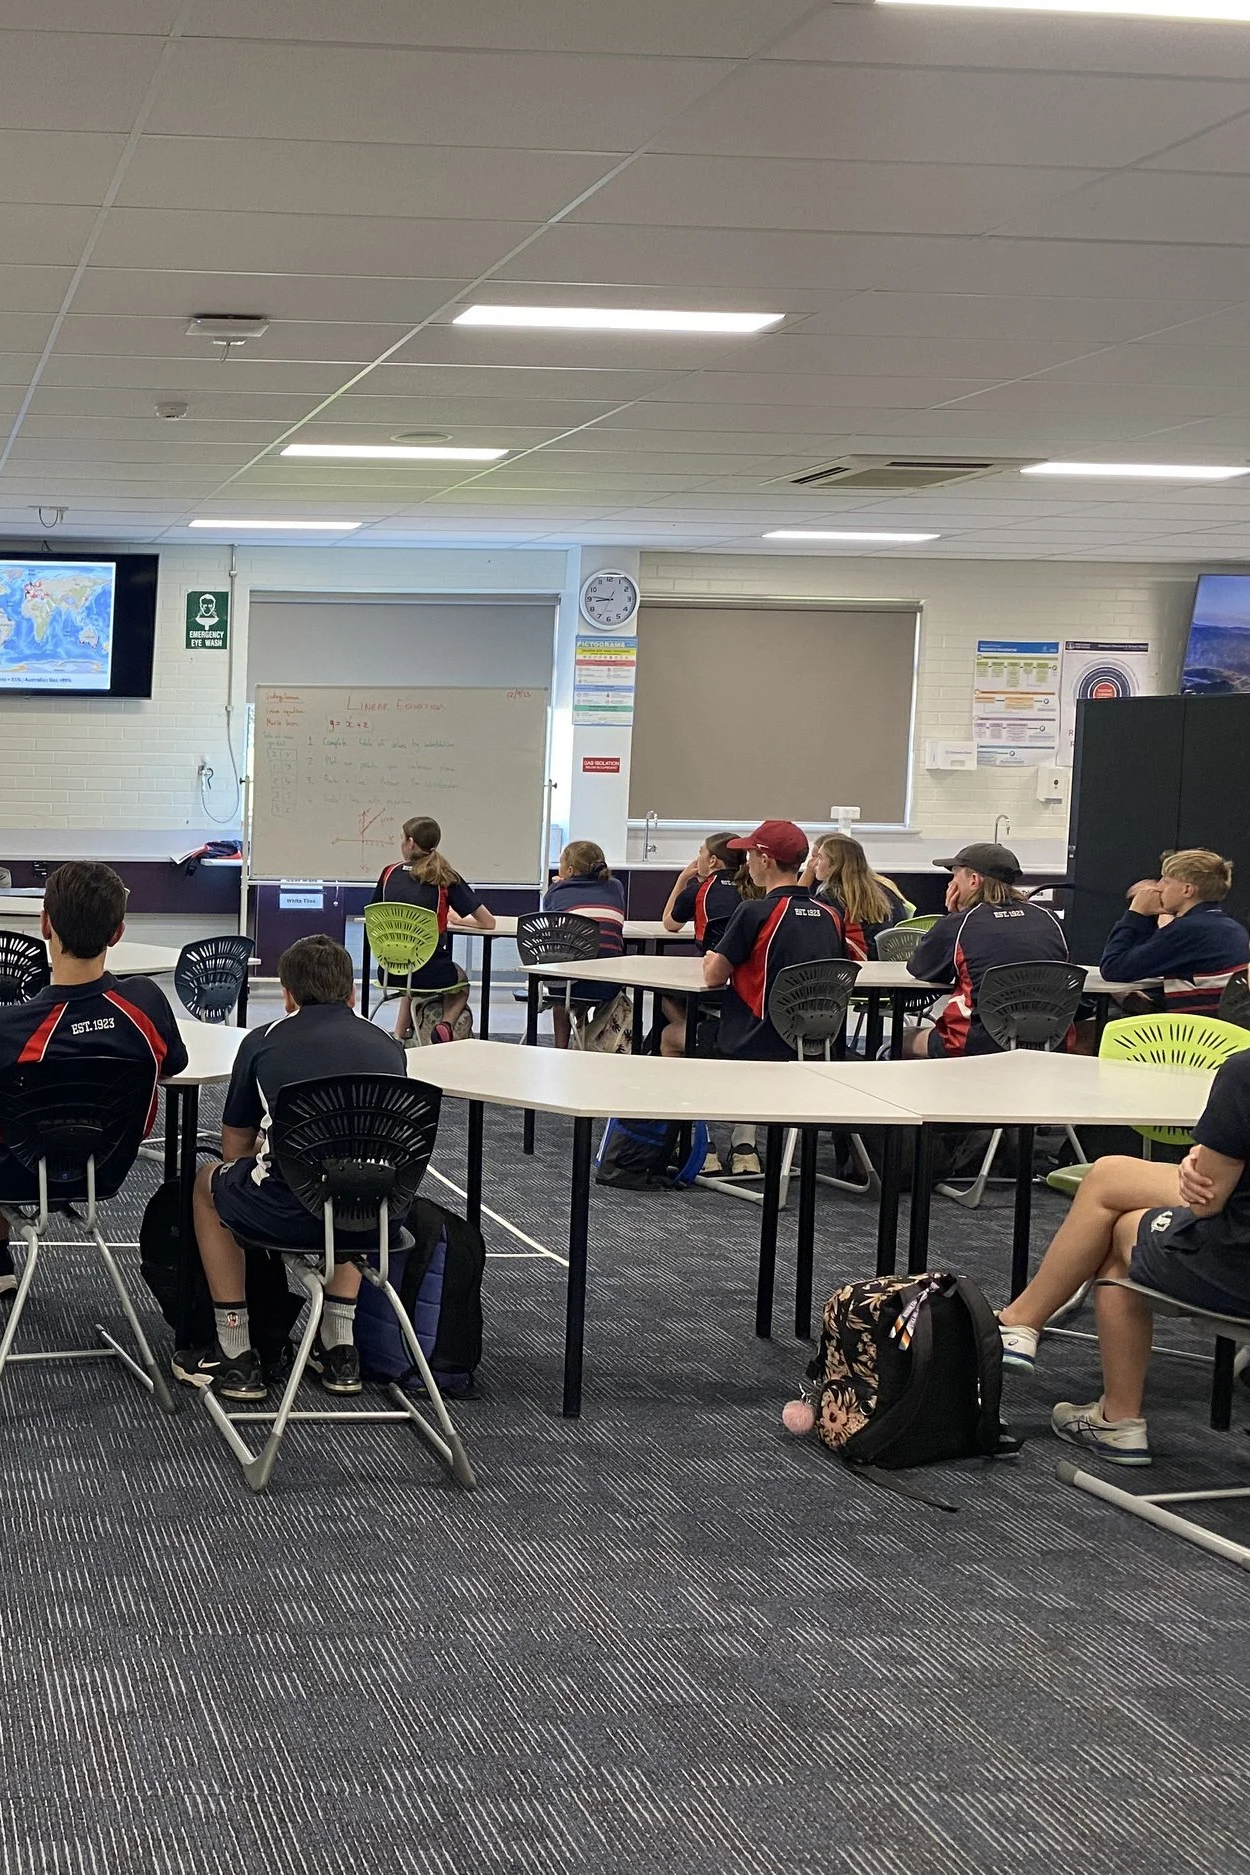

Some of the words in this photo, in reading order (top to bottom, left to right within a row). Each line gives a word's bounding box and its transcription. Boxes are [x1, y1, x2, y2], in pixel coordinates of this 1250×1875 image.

[191, 639, 202, 647] EYE
[205, 639, 222, 647] WASH
[807, 909, 821, 917] 1923
[1009, 909, 1025, 917] 1923
[70, 1021, 93, 1035] EST.
[93, 1017, 115, 1031] 1923
